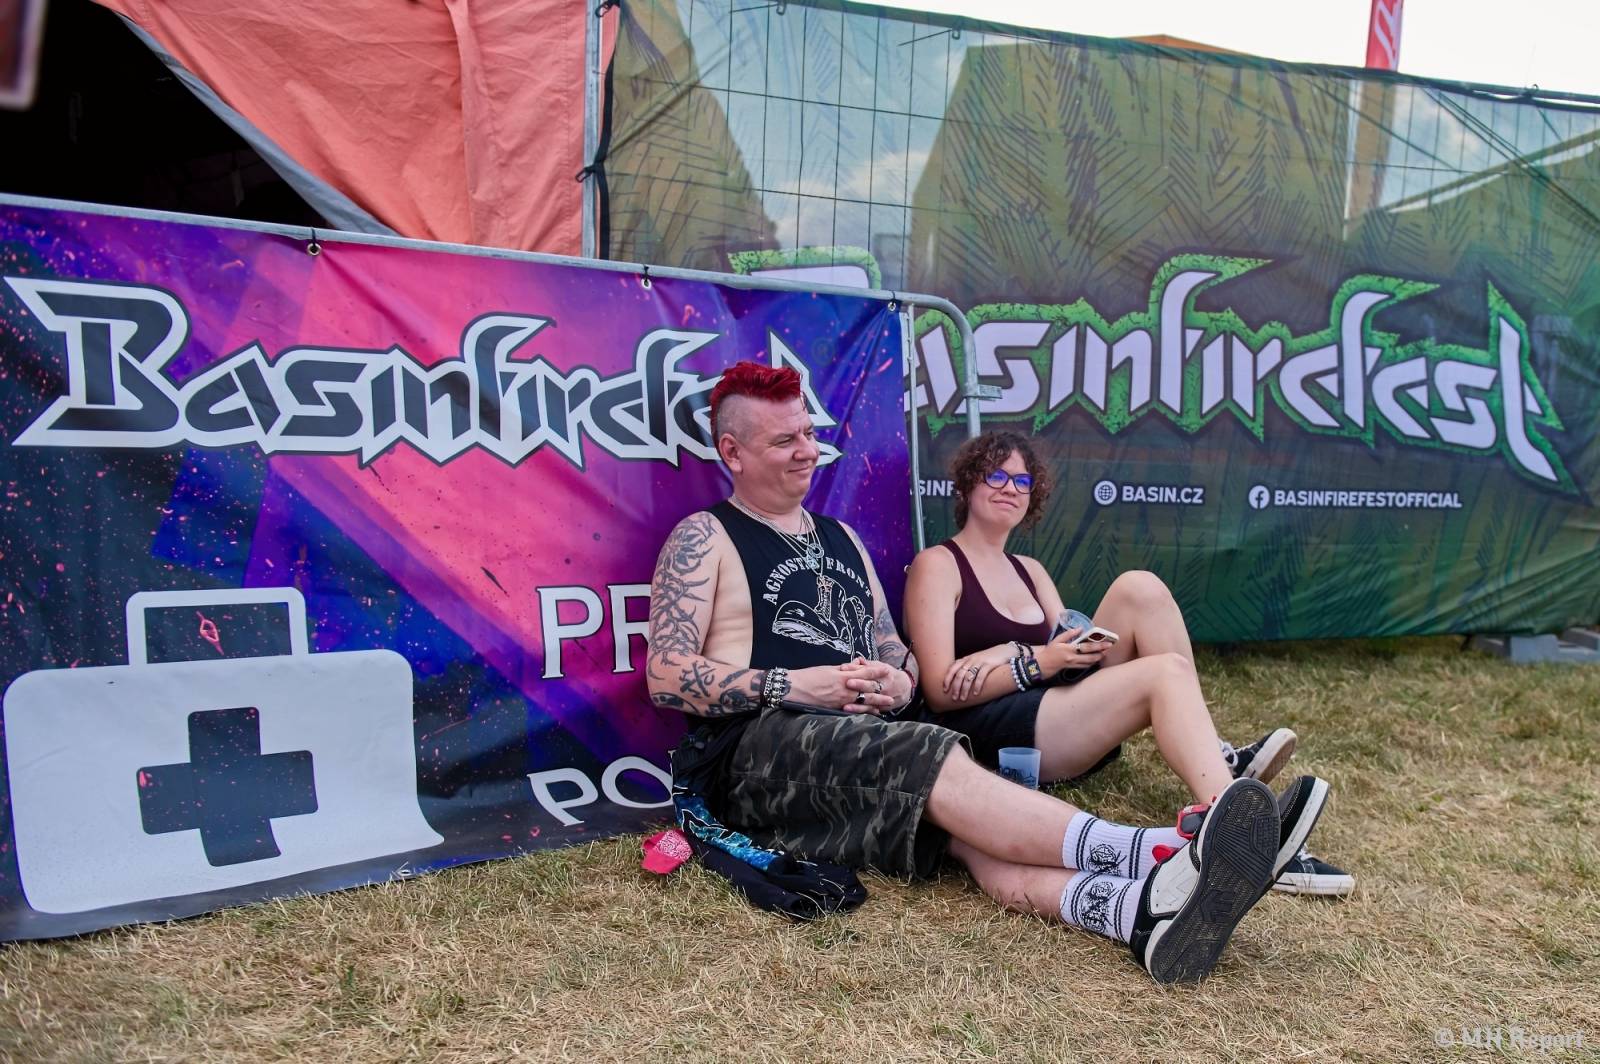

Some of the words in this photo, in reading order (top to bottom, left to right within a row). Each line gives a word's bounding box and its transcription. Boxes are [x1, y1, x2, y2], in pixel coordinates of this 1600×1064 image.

[4, 275, 843, 470] Basinfirefe
[735, 250, 1570, 488] asinfirefest
[1122, 485, 1204, 504] BASIN.CZ
[1274, 489, 1463, 508] BASINFIREFESTOFFICIAL
[763, 556, 814, 605] AGNOST
[536, 583, 651, 680] PR
[526, 752, 673, 828] PO
